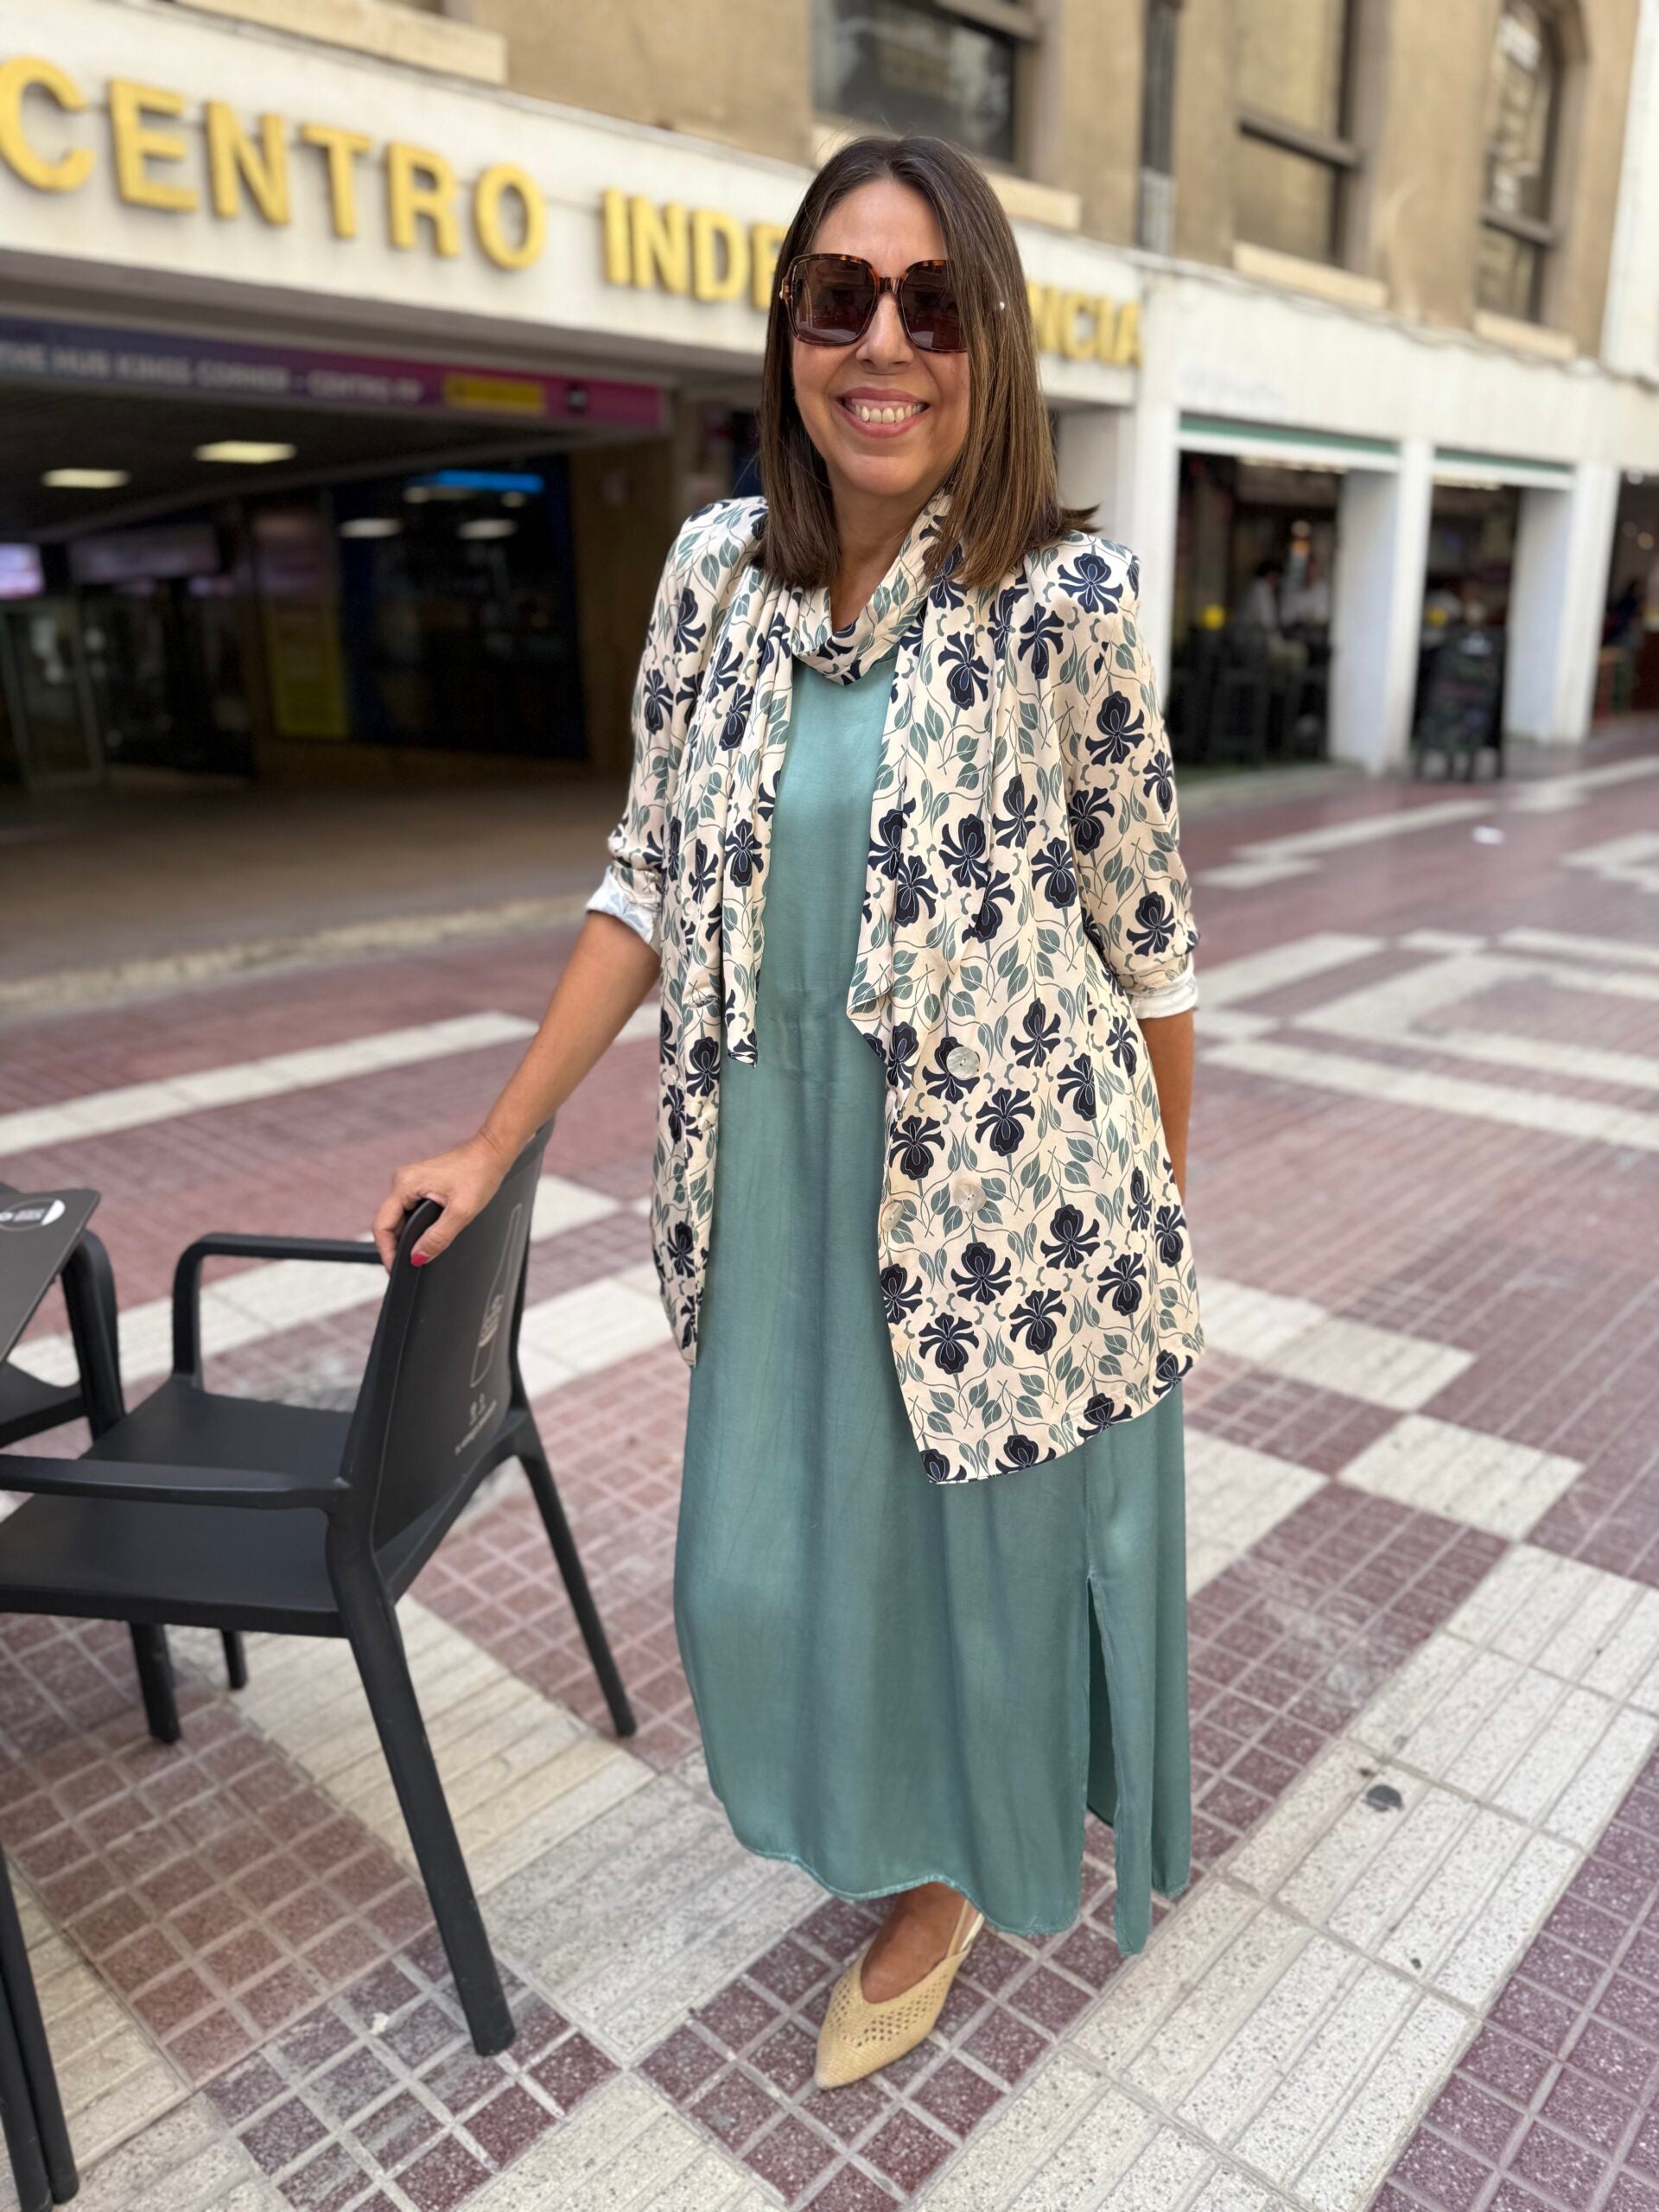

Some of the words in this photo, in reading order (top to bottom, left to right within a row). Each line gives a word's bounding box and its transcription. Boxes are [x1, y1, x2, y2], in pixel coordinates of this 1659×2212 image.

[0, 55, 548, 270] CENTRO
[601, 187, 1142, 371] INDENCIA
[52, 346, 111, 378] HUB
